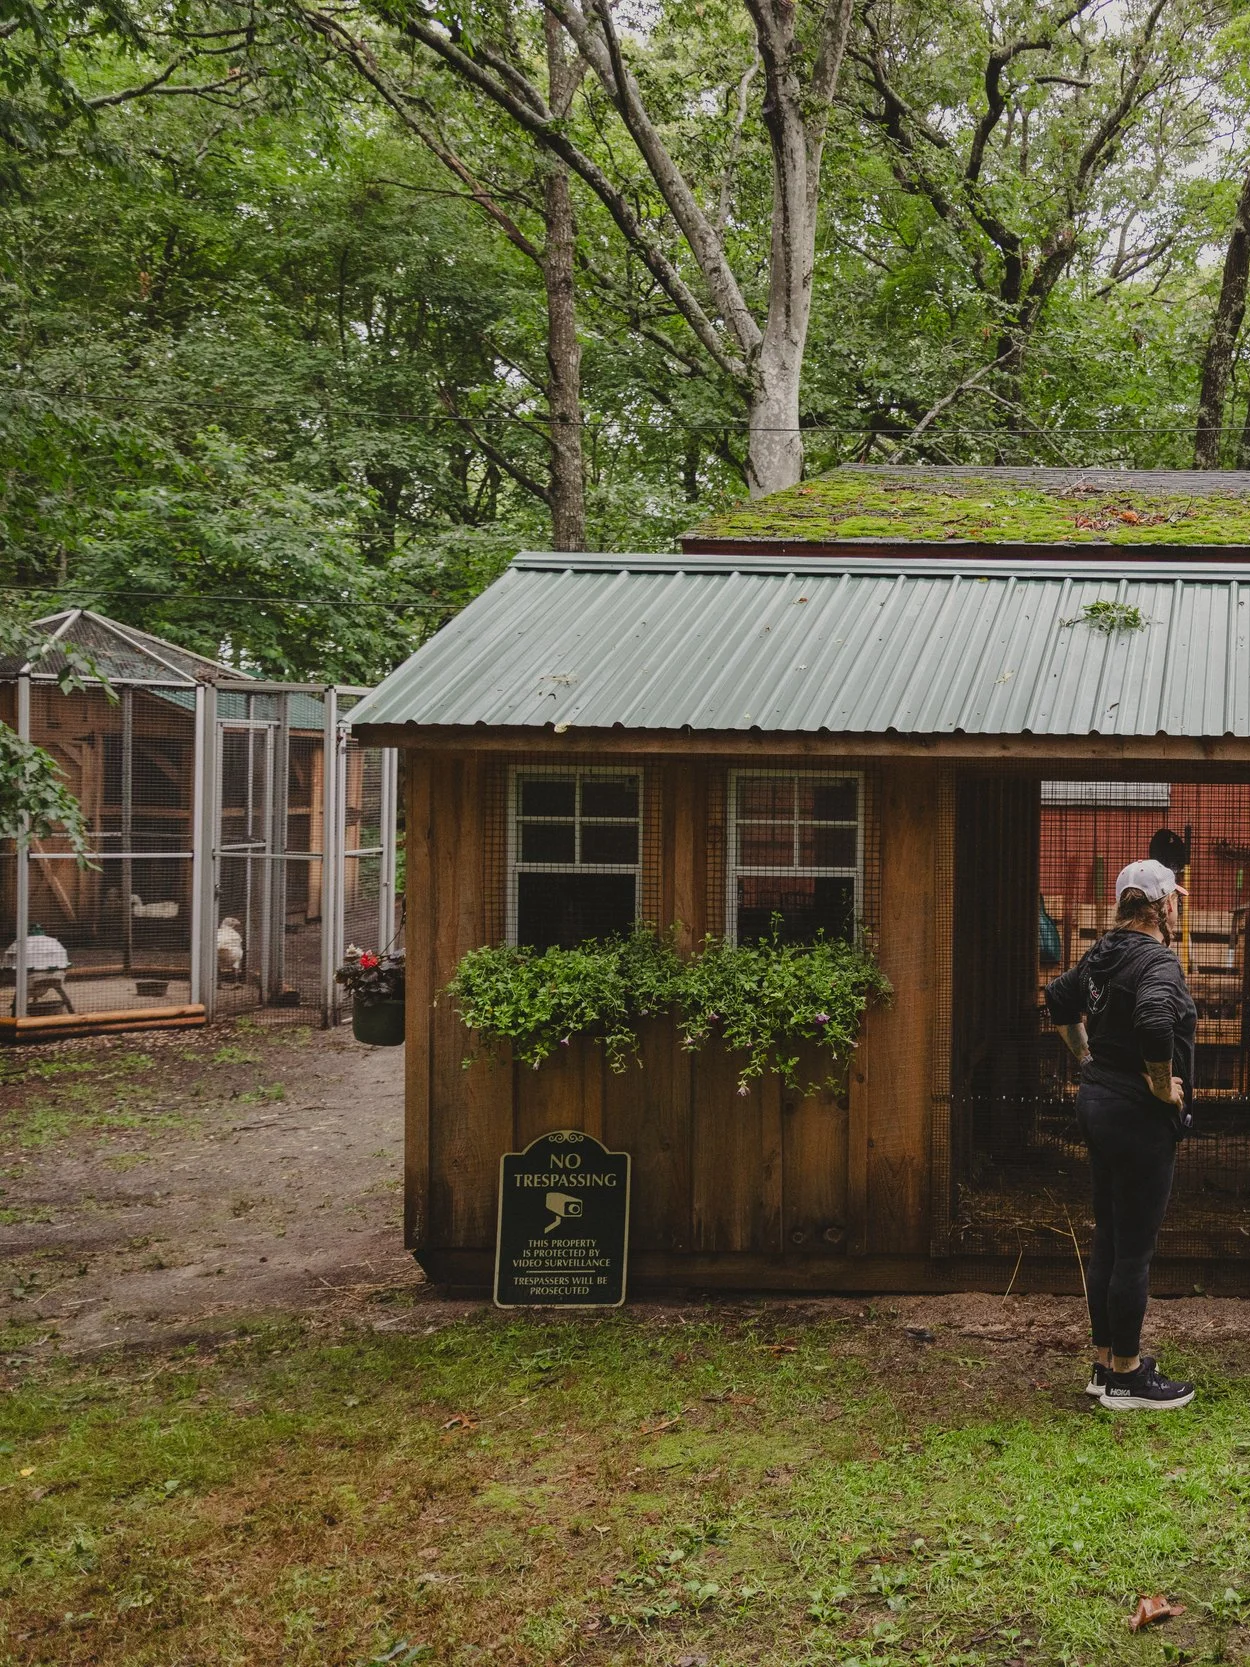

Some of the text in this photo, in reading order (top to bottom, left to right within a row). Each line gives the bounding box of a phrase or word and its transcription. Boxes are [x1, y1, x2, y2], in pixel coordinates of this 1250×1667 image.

[550, 1153, 581, 1169] NO
[513, 1173, 617, 1187] TRESPASSING
[528, 1239, 597, 1248] THIS PROPERTY
[523, 1249, 600, 1258] IS PROTECTED BY
[512, 1258, 611, 1268] VIDEO SURVEILLANCE
[513, 1276, 608, 1286] TRESPASSERS WILL BE
[530, 1286, 590, 1296] PROSECUTED
[1110, 1388, 1131, 1396] HOKA
